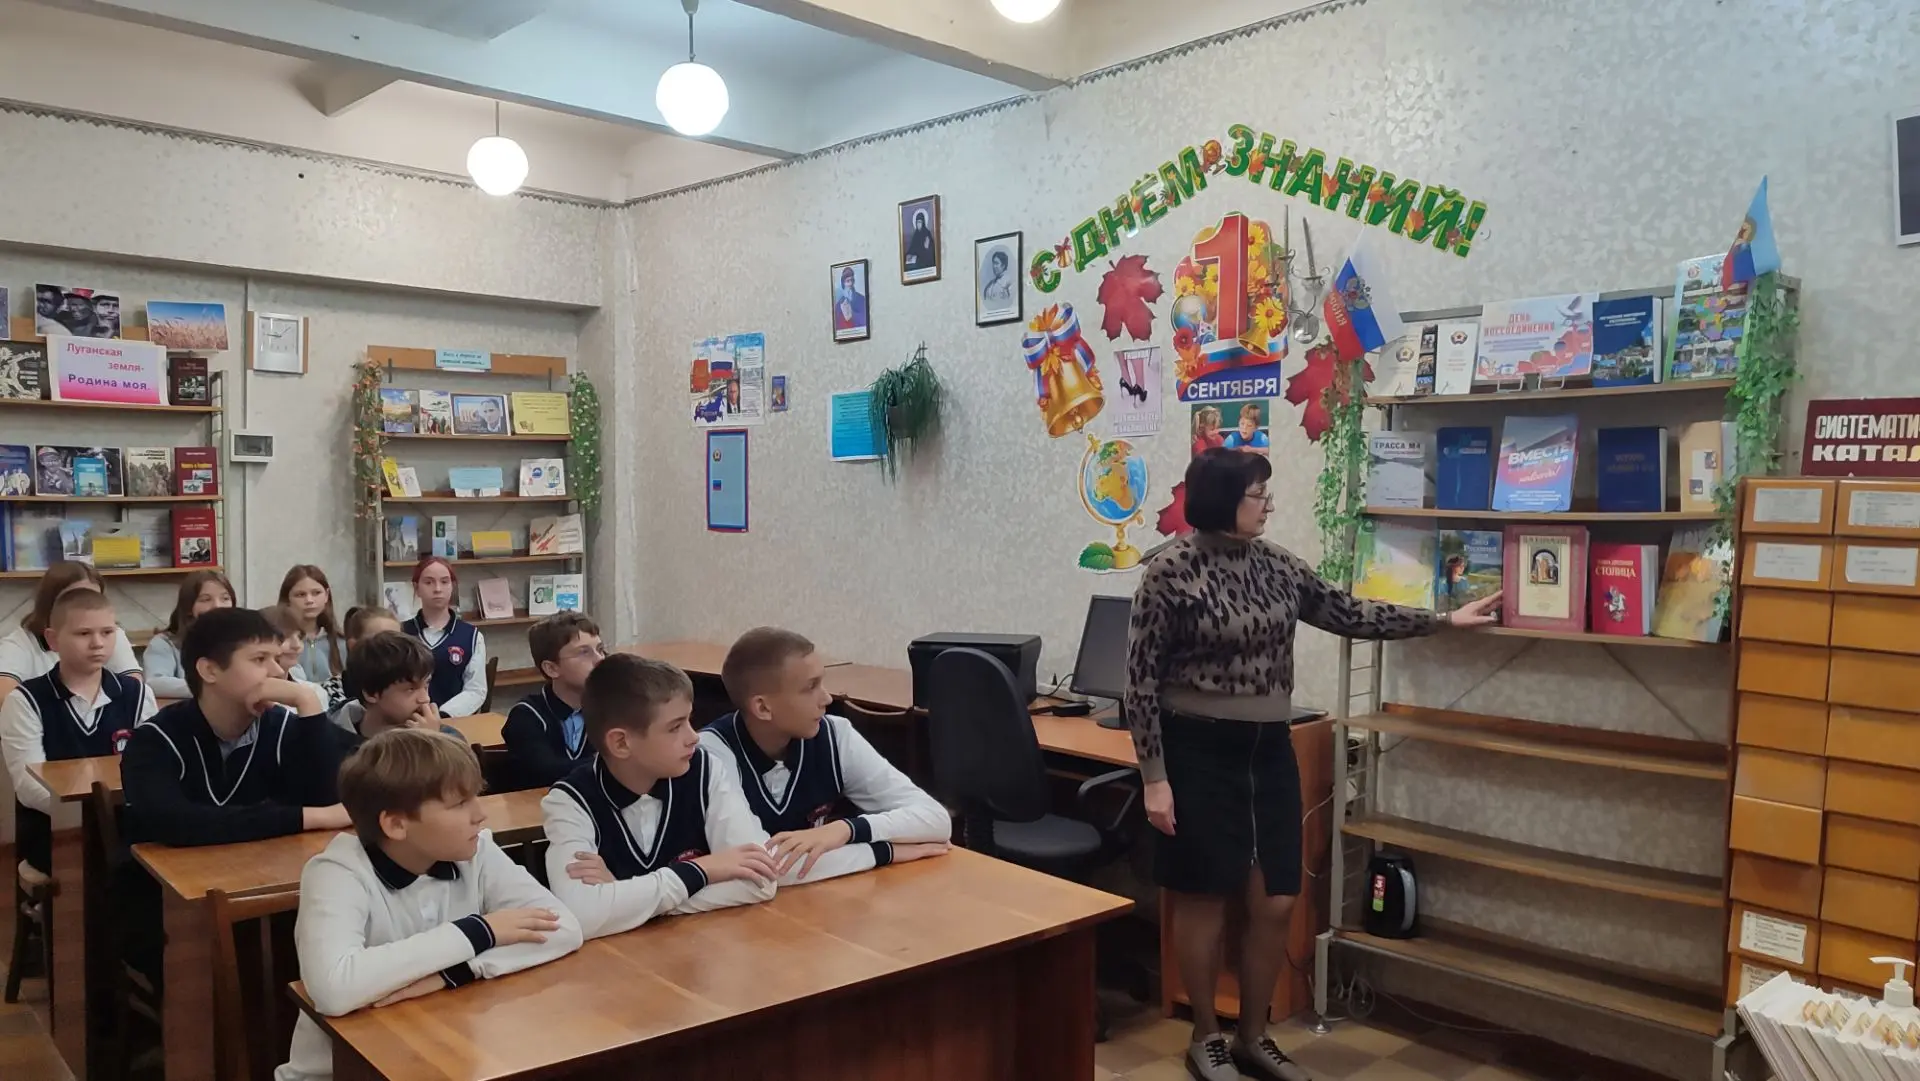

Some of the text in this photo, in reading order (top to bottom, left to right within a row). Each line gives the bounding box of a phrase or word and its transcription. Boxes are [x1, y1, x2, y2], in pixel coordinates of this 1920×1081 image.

[1031, 123, 1488, 293] С ДНЁМ ЗНАНИЙ!
[1194, 210, 1248, 343] 1
[67, 342, 123, 357] Луганская
[68, 373, 118, 388] Родина
[1186, 376, 1278, 399] СЕНТЯБРЯ
[1815, 414, 1920, 439] СИСТЕМАТИ
[1595, 566, 1637, 580] СТОЛИЦА
